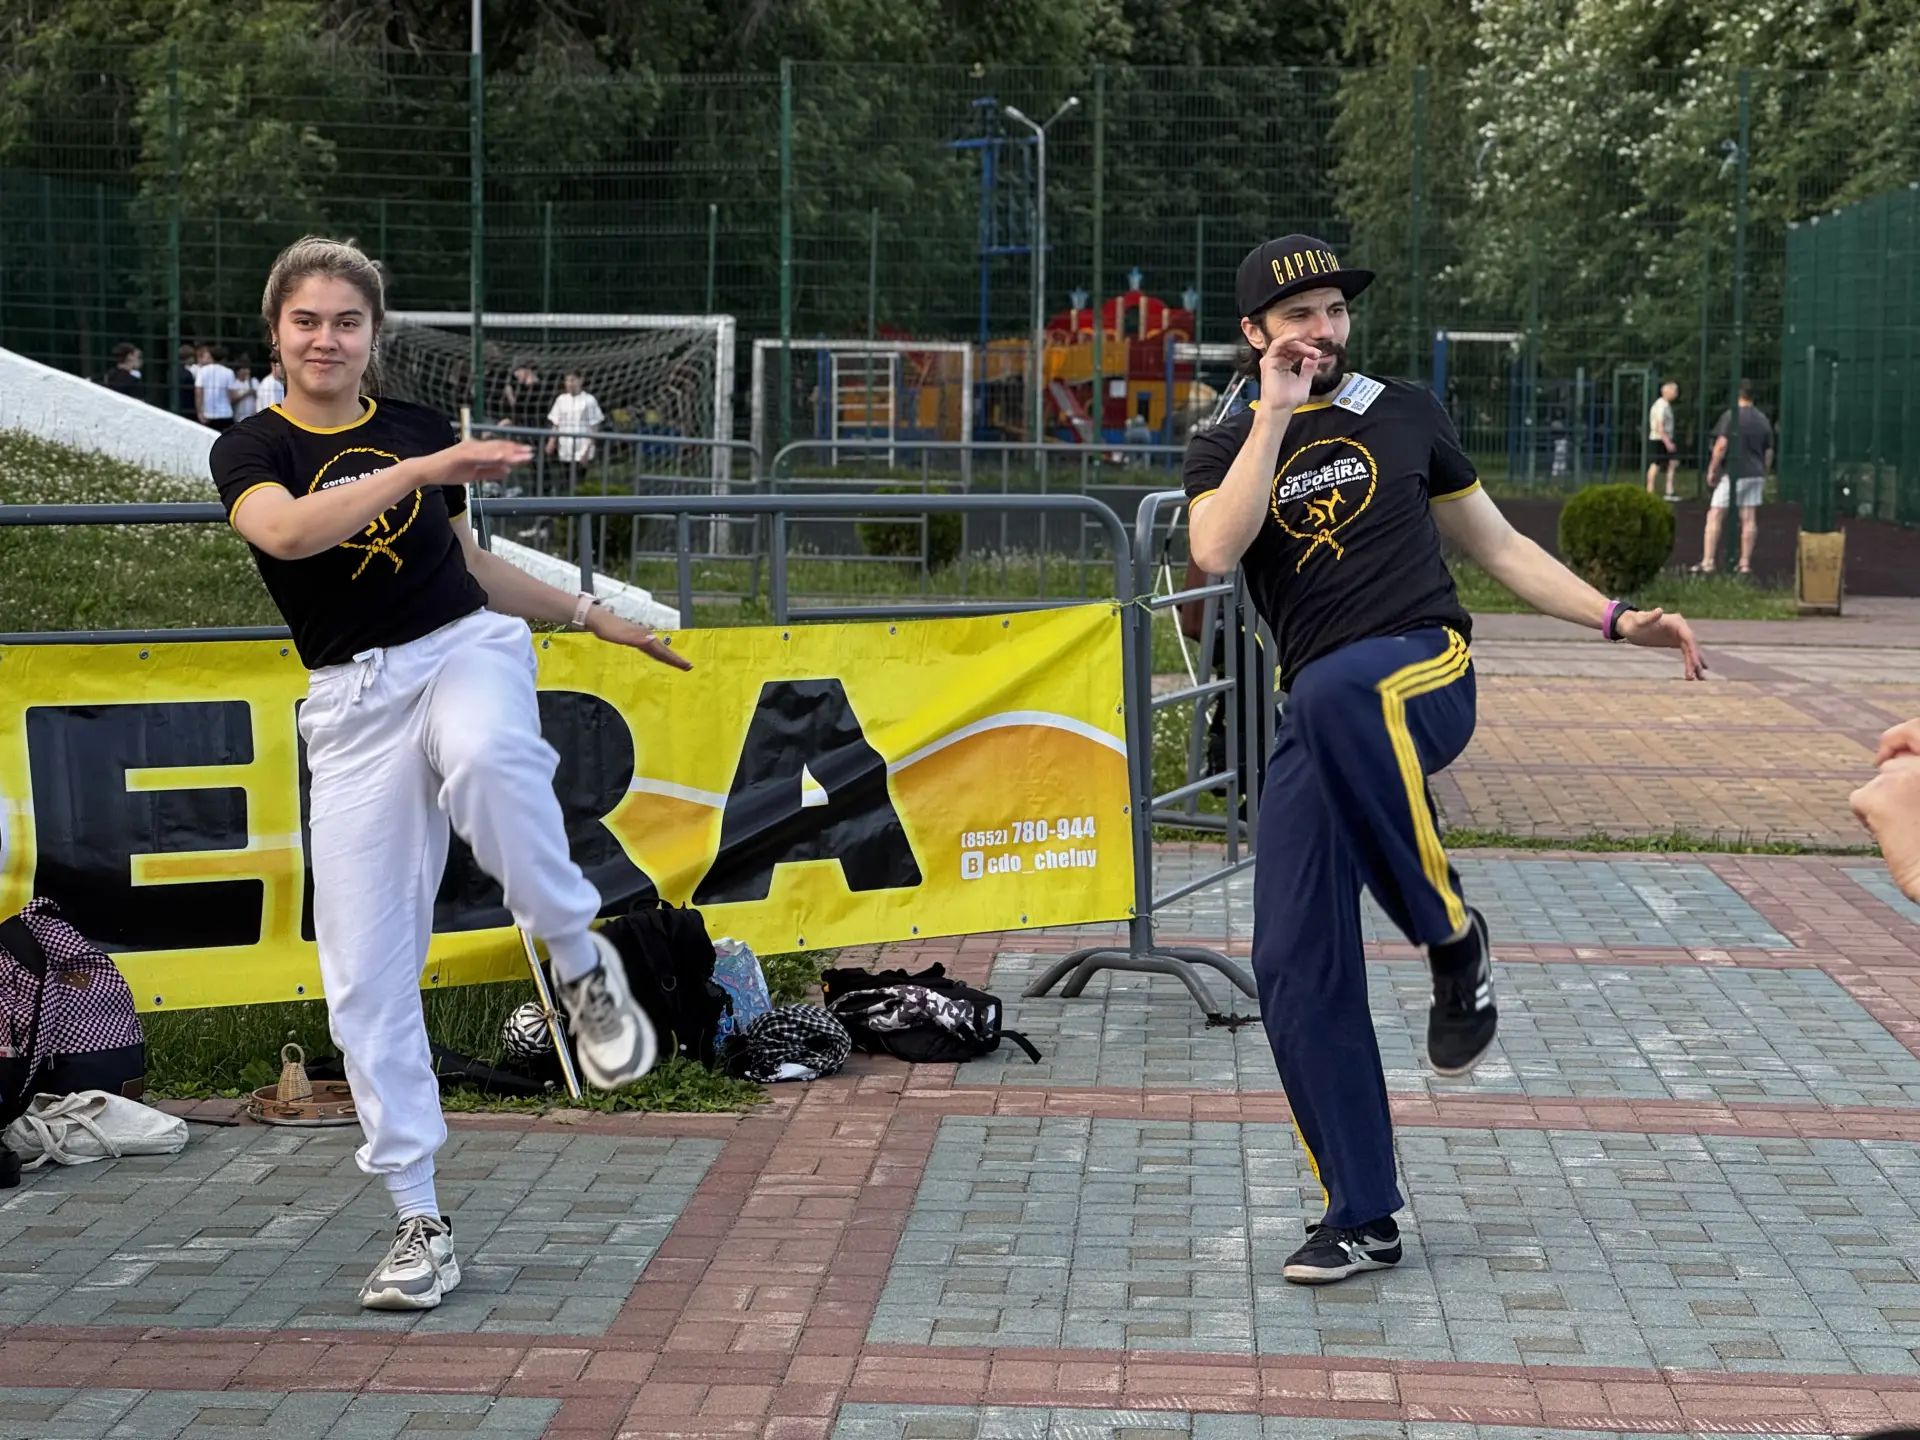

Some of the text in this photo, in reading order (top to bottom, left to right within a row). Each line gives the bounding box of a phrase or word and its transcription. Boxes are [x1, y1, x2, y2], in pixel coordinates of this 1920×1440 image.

[322, 475, 357, 489] Cordão
[1279, 462, 1368, 498] CAPOEIRA
[1286, 470, 1318, 484] Cordão
[1320, 464, 1332, 474] de
[1011, 816, 1096, 844] 780-944
